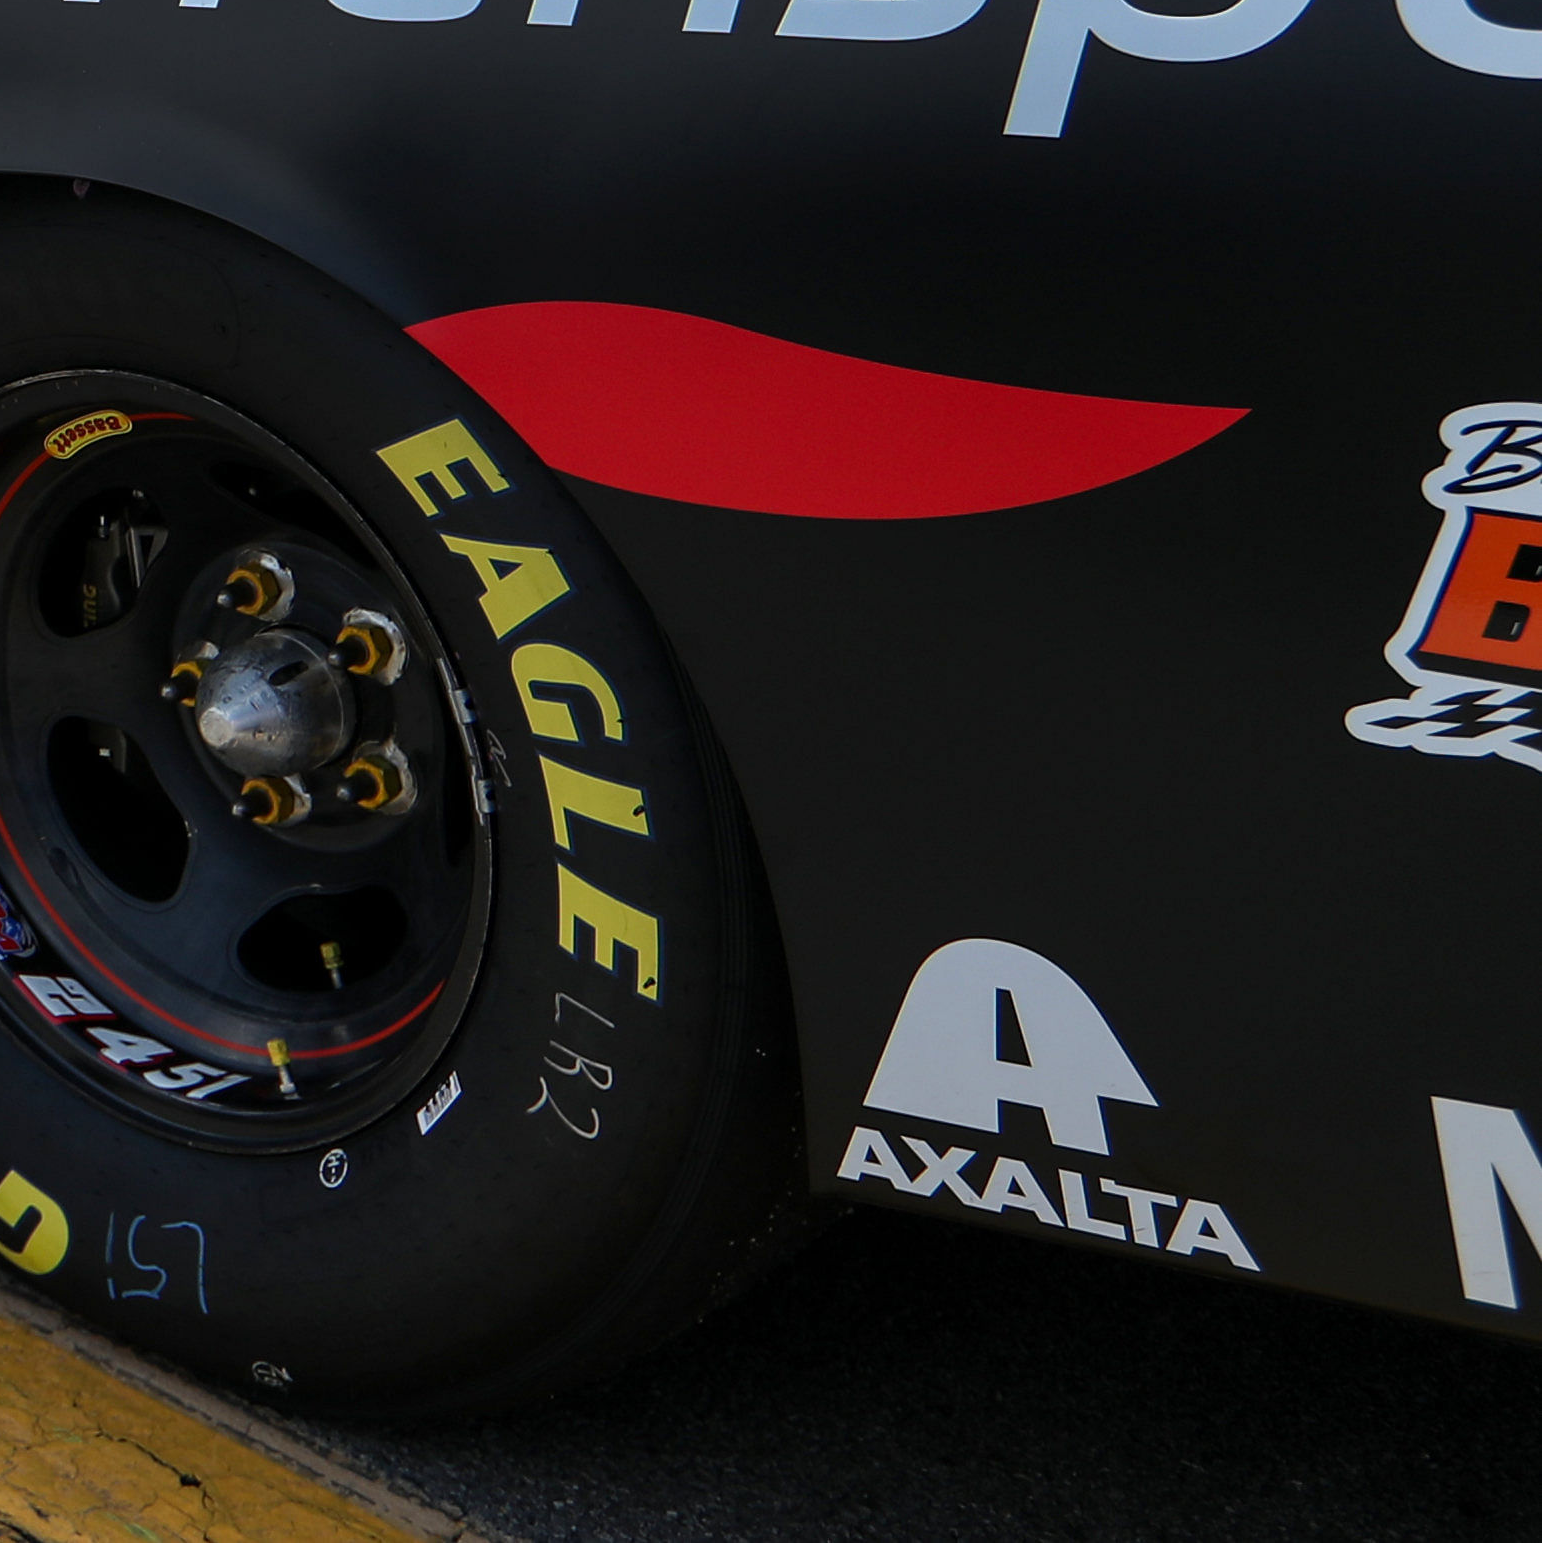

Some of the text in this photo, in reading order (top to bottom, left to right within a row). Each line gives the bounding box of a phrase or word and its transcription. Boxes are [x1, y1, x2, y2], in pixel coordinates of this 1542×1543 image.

[50, 415, 122, 454] Bassett
[376, 418, 660, 1001] EAGLE
[836, 1126, 1261, 1272] AXALTA
